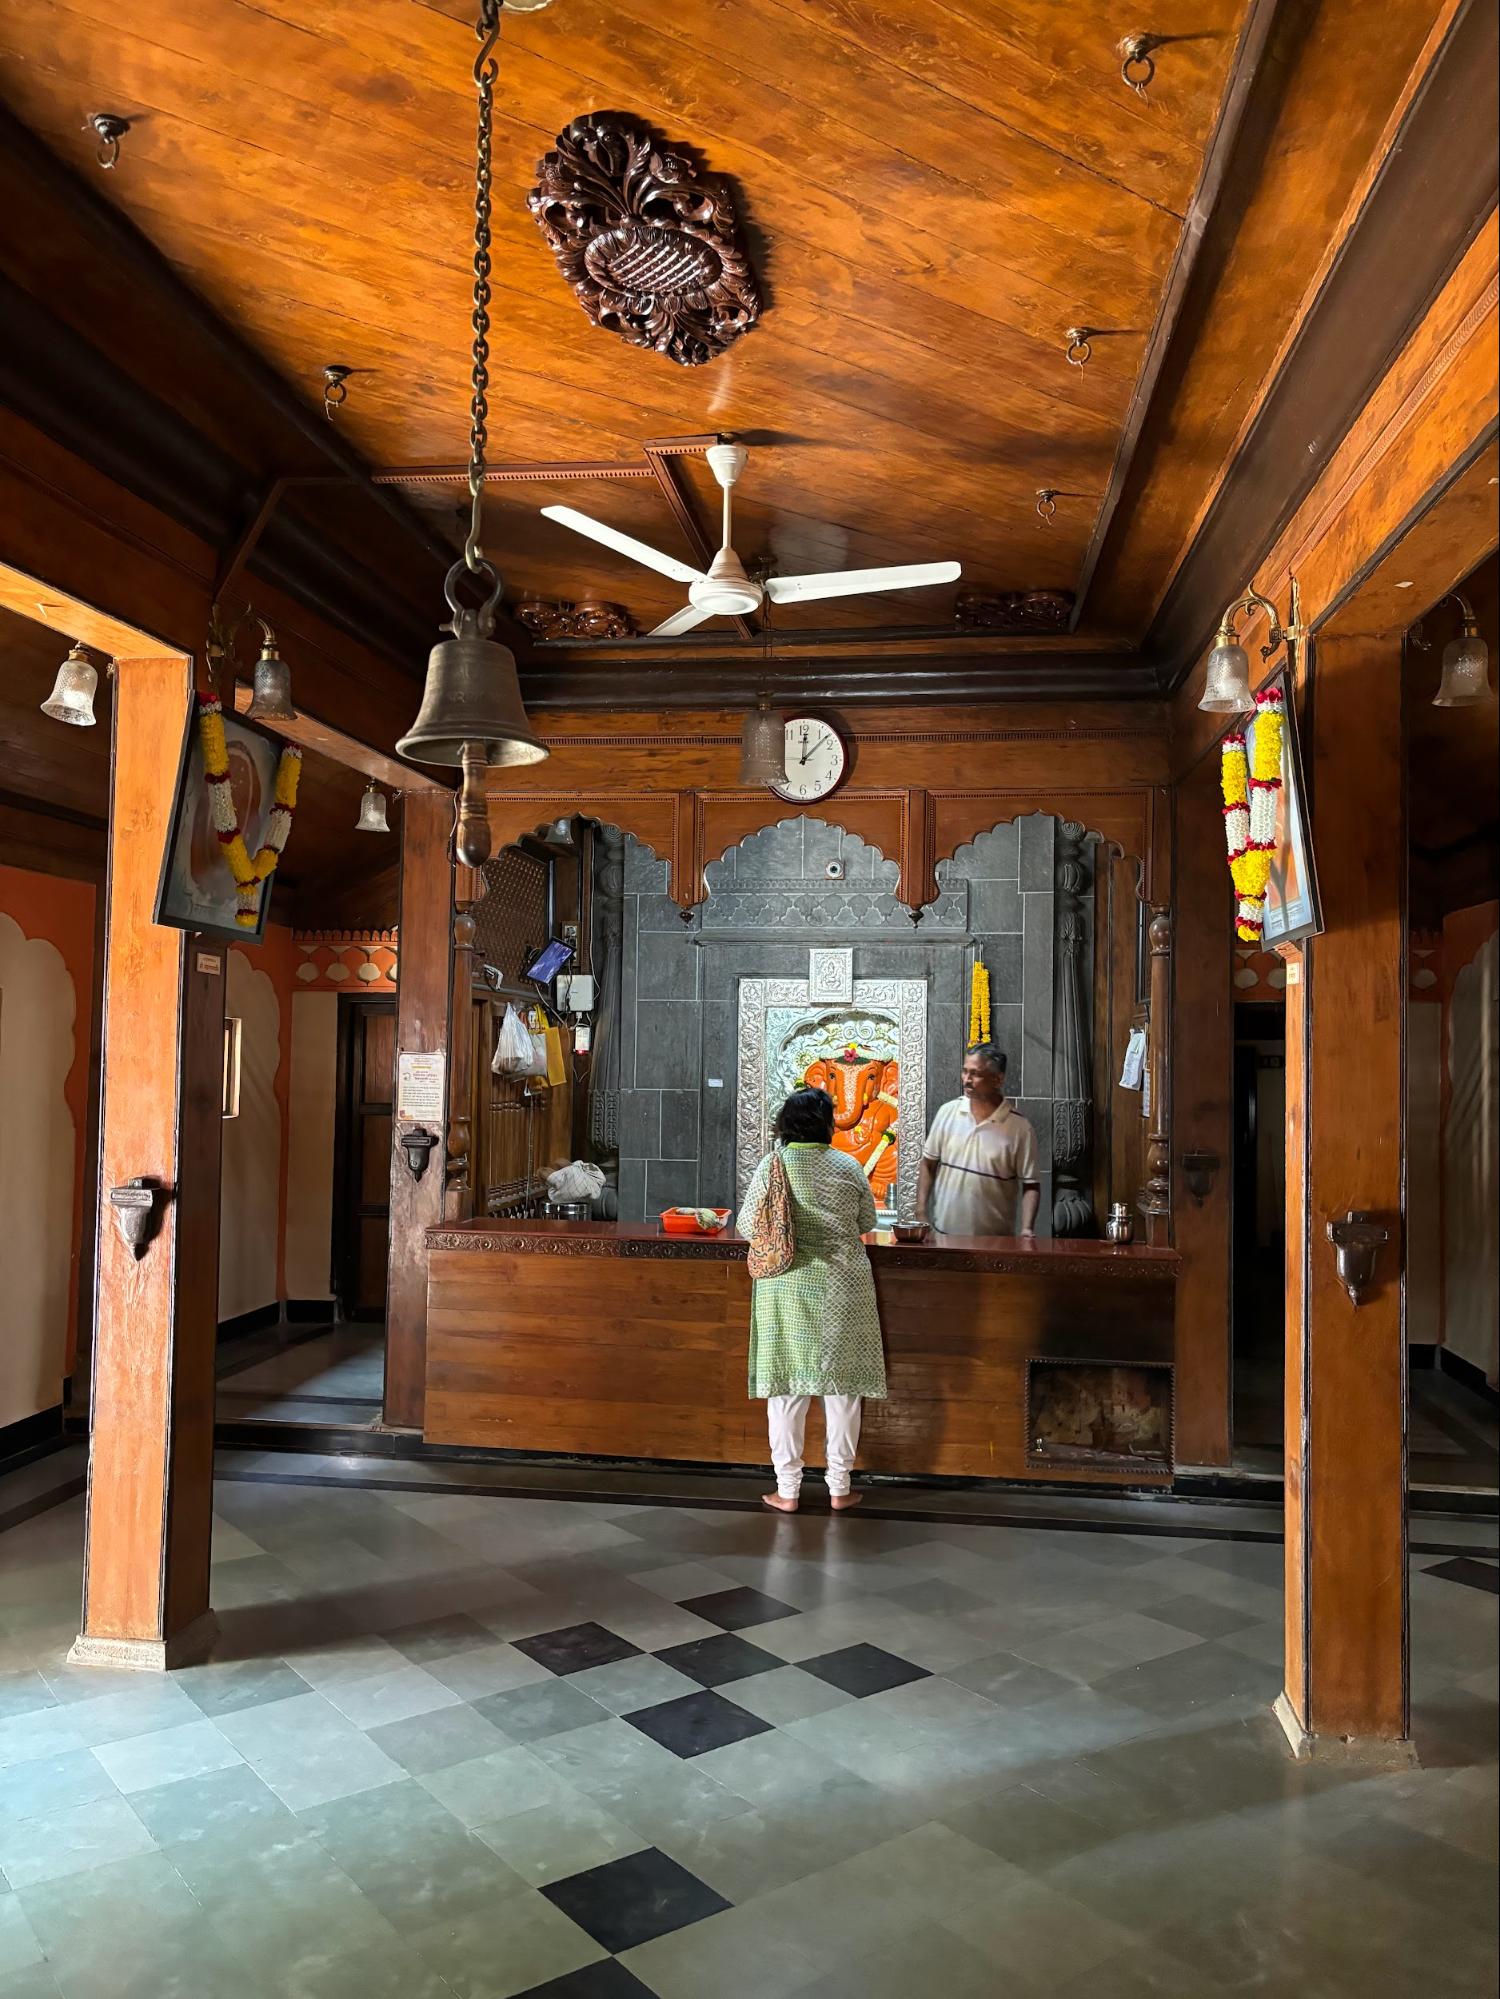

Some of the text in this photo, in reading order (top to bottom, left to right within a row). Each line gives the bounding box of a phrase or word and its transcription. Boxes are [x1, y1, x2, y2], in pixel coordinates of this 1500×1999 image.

[786, 729, 793, 740] 11
[800, 725, 809, 736] 12
[826, 740, 833, 750] 2
[831, 755, 838, 765] 3
[825, 770, 832, 780] 4
[800, 785, 806, 795] 6
[814, 781, 821, 791] 5
